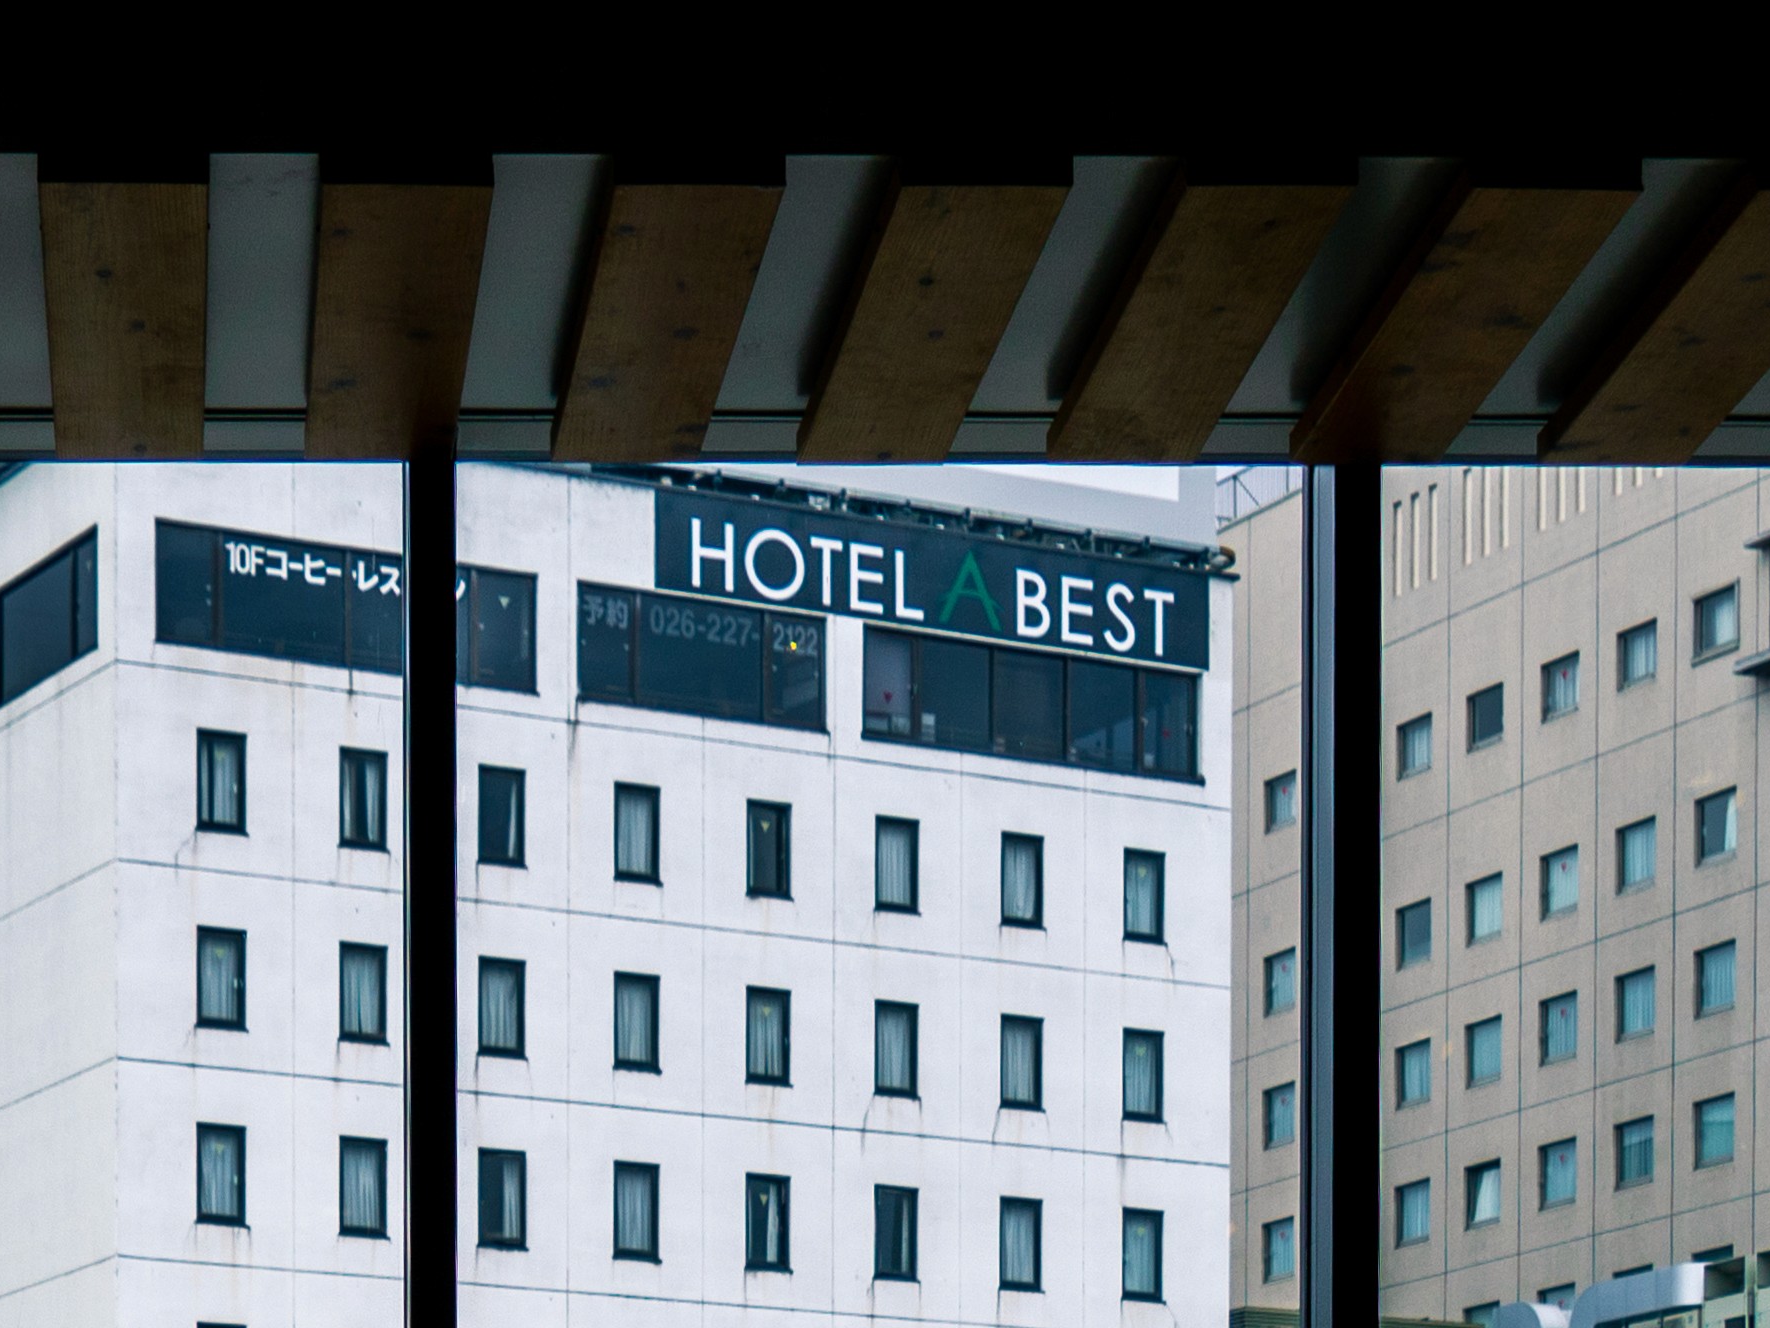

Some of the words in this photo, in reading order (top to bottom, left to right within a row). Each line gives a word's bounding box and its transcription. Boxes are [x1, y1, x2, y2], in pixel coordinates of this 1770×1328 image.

[225, 541, 465, 600] 10Fコーヒー・レス
[690, 517, 924, 622] HOTEL
[939, 550, 1001, 632] A
[1016, 568, 1174, 656] BEST
[586, 597, 628, 630] 予約
